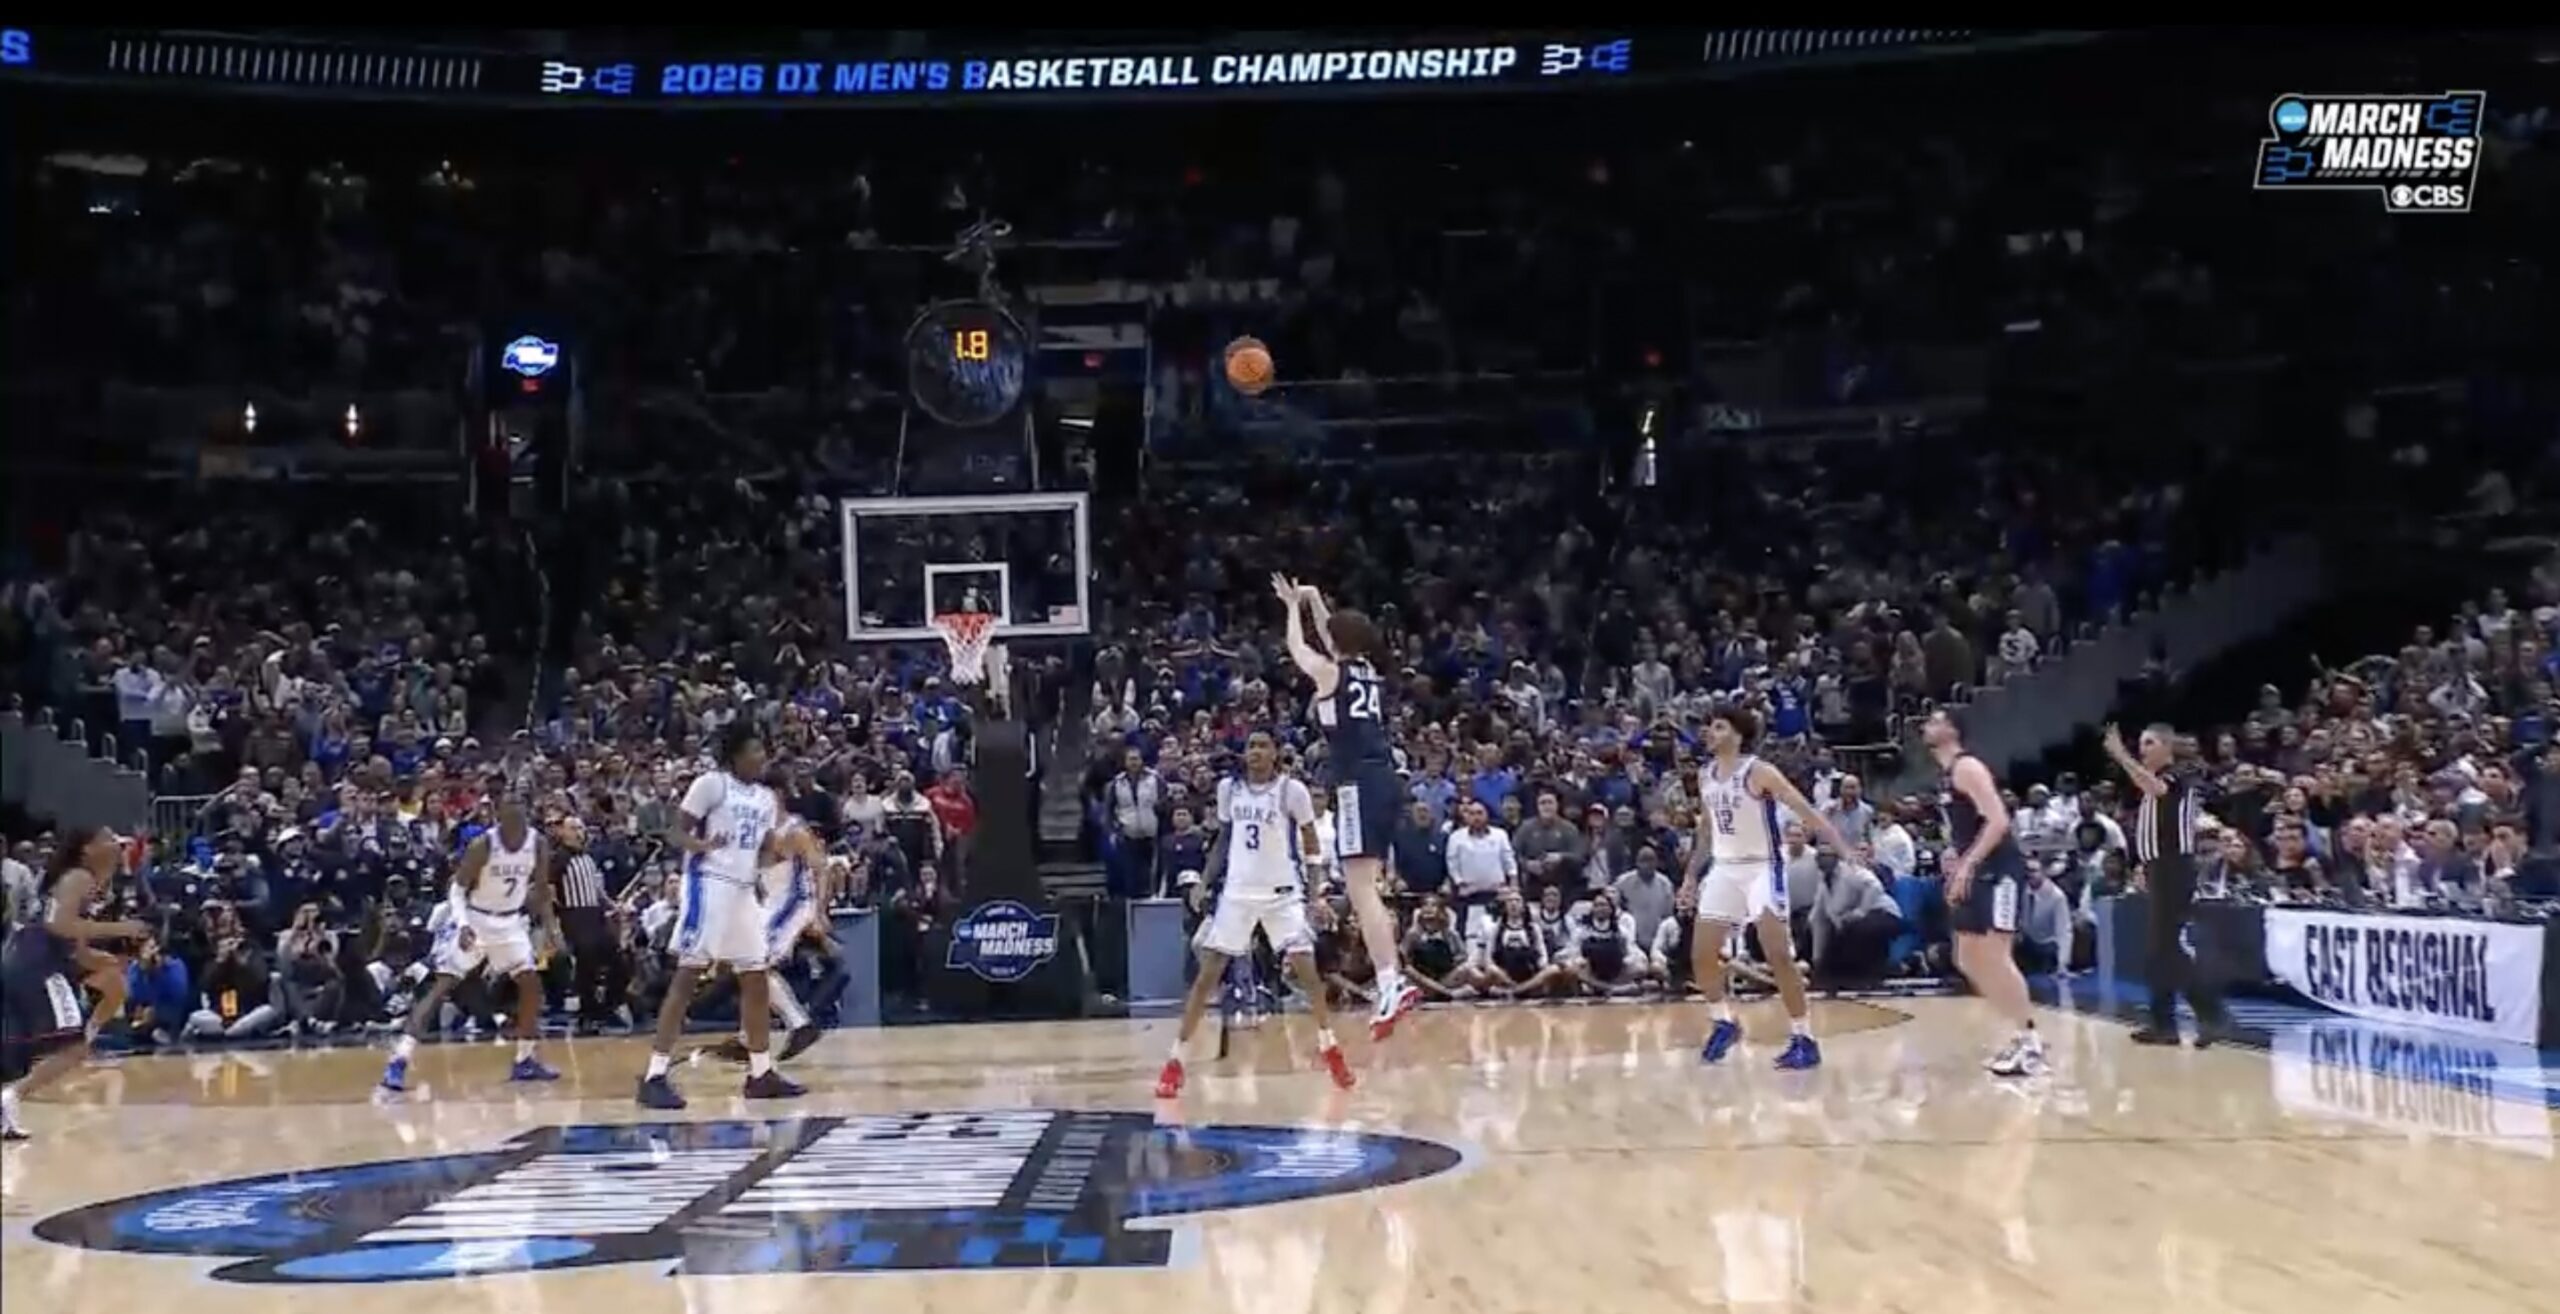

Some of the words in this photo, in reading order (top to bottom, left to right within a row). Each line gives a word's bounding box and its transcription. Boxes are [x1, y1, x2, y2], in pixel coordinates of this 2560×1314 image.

[661, 63, 765, 93] 2026
[777, 63, 822, 92] DI
[834, 62, 950, 91] MEN'S
[963, 57, 1199, 89] BASKETBALL
[1211, 47, 1516, 84] CHAMPIONSHIP
[956, 331, 988, 359] 1.8
[1348, 682, 1382, 723] 24
[1233, 804, 1277, 826] DUKE
[1714, 809, 1735, 835] 12
[739, 822, 758, 850] 21
[1246, 824, 1260, 850] 3
[503, 877, 518, 898] 7
[973, 921, 1029, 940] MARCH
[979, 938, 1054, 956] MADNESS
[2305, 924, 2359, 1004] EAST
[2365, 928, 2495, 1022] REGIONAL
